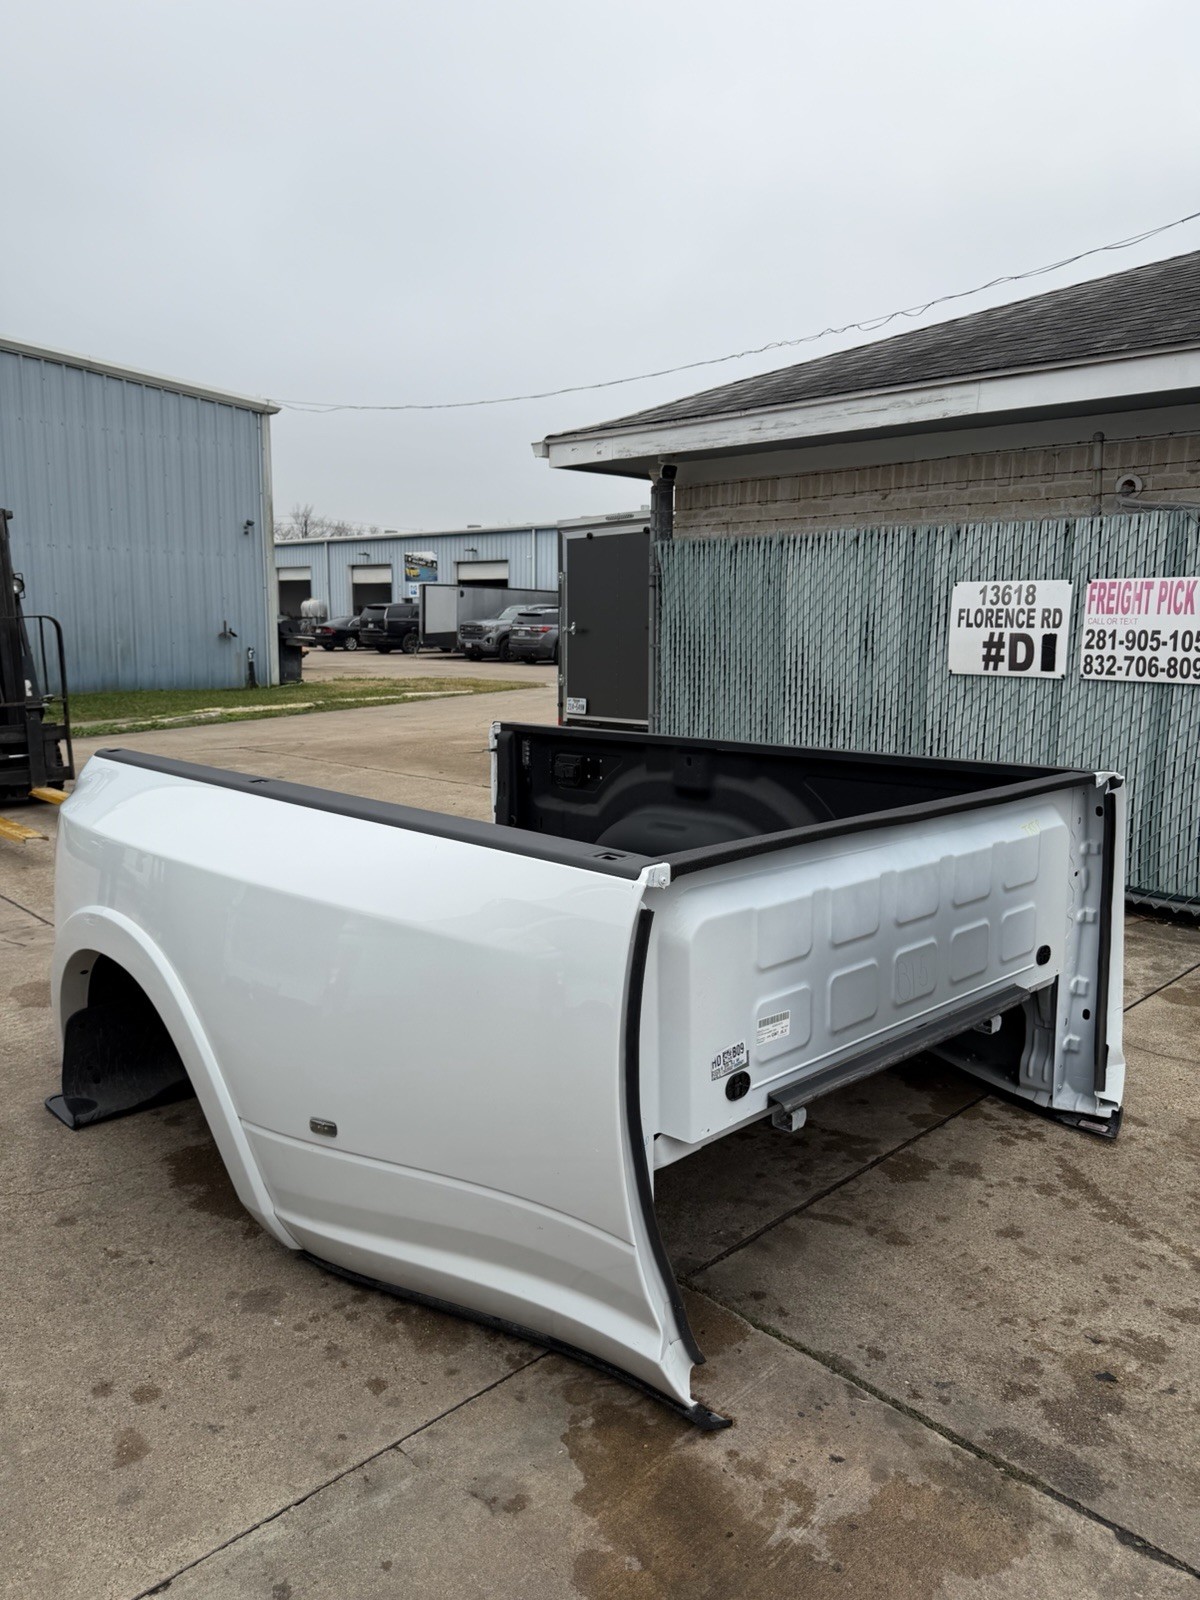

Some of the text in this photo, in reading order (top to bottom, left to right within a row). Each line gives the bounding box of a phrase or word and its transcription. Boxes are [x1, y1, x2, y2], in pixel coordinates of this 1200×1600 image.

[979, 584, 1037, 606] 13618
[1088, 581, 1199, 615] FREIGHT PICK
[957, 608, 1063, 629] FLORENCE RD
[1120, 617, 1138, 625] TEXT
[1083, 654, 1200, 680] 832-706-809
